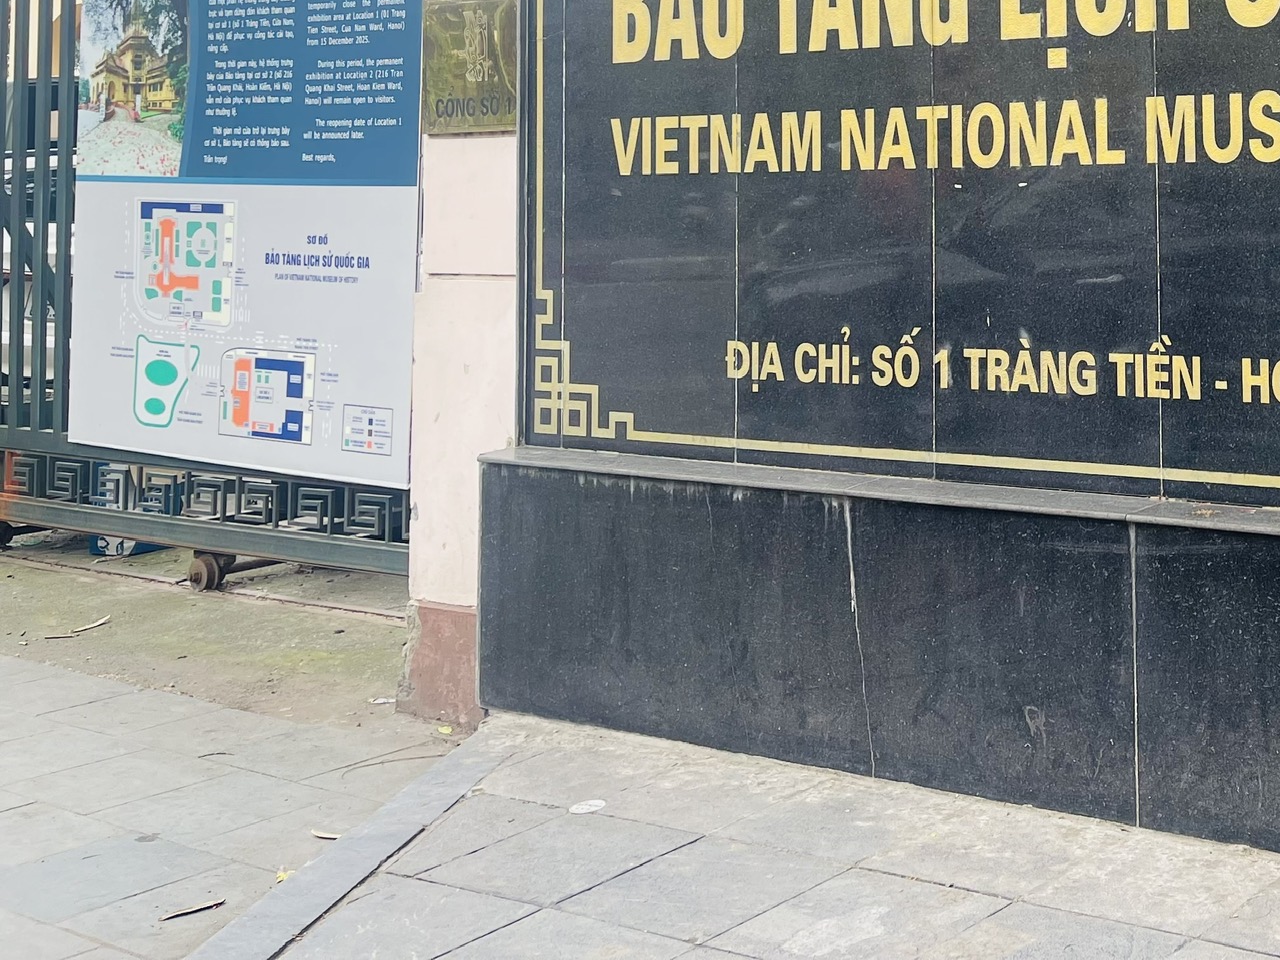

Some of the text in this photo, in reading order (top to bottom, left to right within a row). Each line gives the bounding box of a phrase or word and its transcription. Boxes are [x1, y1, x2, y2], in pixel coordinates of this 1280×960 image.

[610, 110, 822, 174] VIETNAM
[840, 97, 1126, 169] NATIONAL
[725, 340, 784, 393] ĐỊA
[794, 326, 859, 385] CHỈ:
[872, 327, 921, 388] SỐ
[935, 349, 949, 389] 1
[963, 338, 1097, 396] TRÀNG
[1108, 335, 1201, 401] TIỀN
[1215, 380, 1227, 390] -
